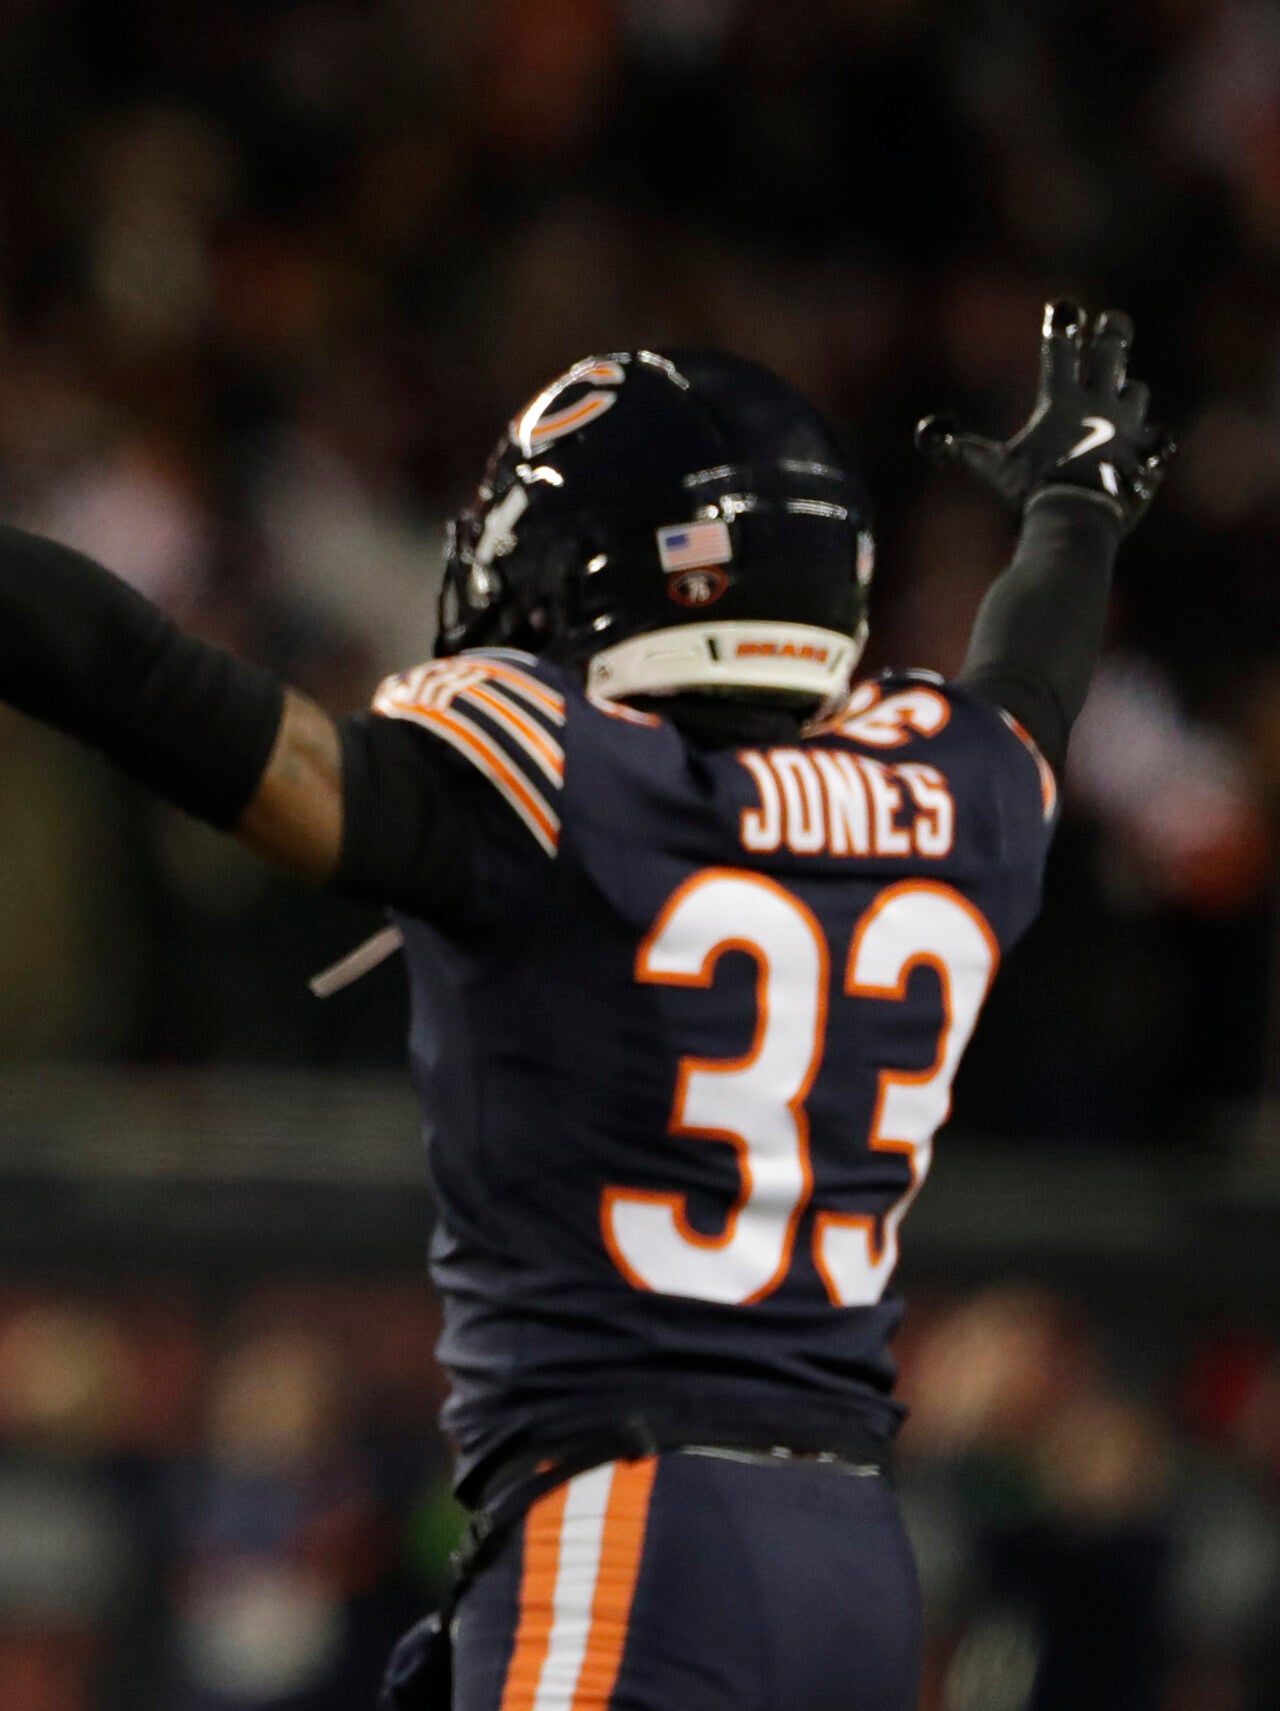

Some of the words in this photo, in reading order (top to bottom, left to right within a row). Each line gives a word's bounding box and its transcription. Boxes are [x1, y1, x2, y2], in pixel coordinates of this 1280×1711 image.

[735, 641, 828, 663] BEARS
[736, 746, 956, 861] JONES
[599, 866, 1000, 1307] 33
